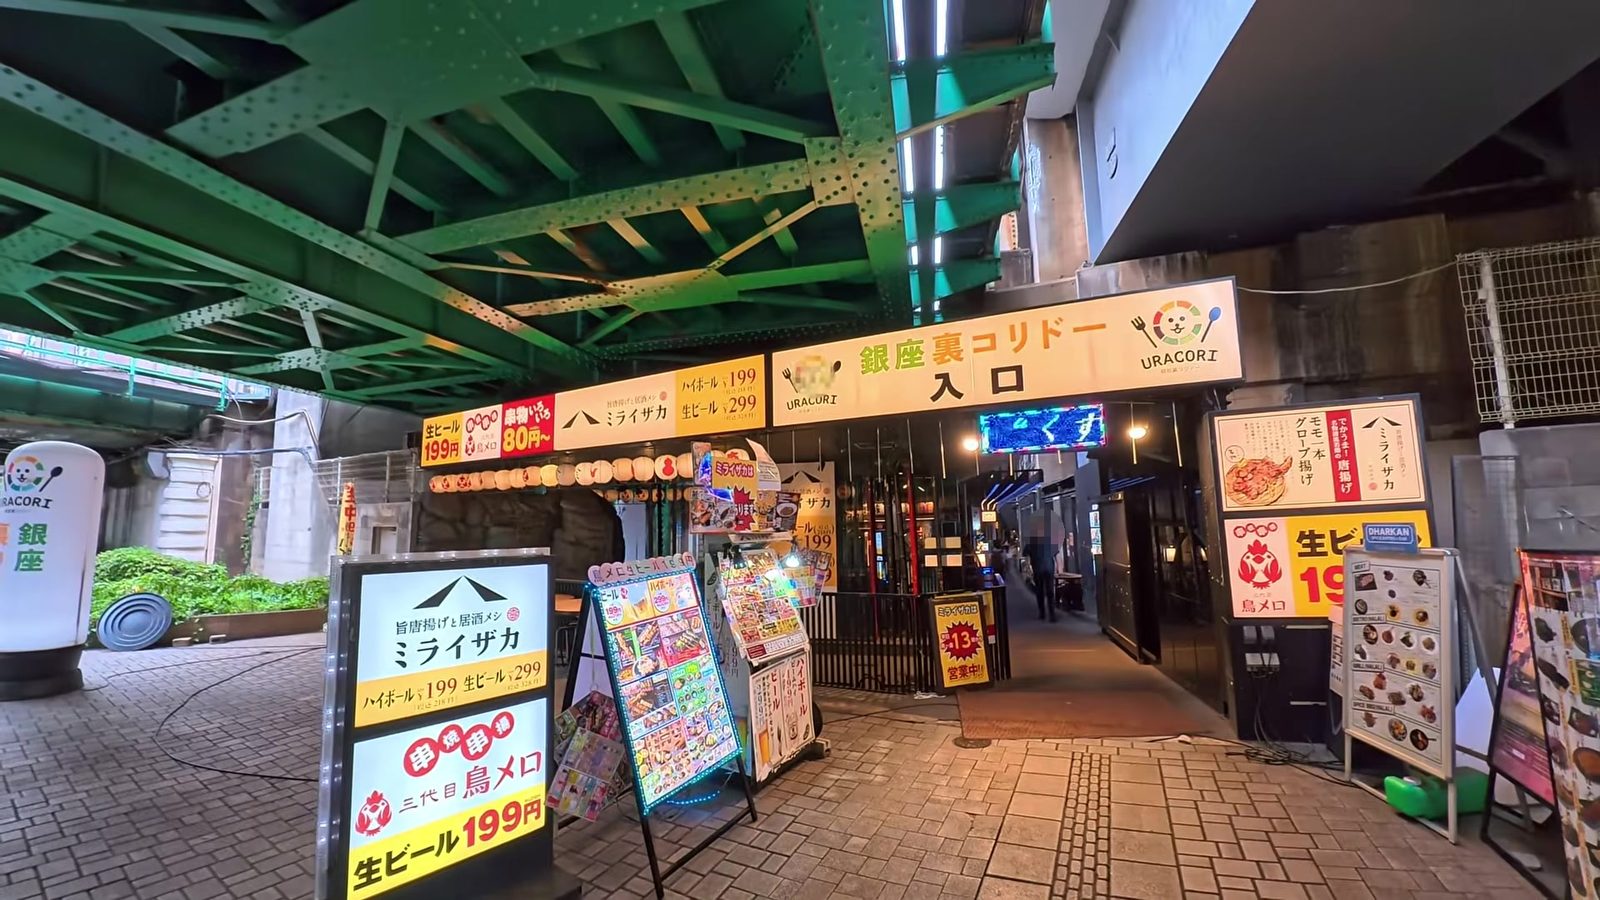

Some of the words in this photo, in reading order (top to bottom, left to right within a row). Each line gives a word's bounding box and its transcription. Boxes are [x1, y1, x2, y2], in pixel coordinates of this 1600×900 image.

[859, 317, 1107, 374] 銀座裏コリドー
[1141, 349, 1218, 370] URACORI
[681, 376, 719, 393] ハイボール
[930, 364, 1024, 402] 入口
[607, 404, 668, 427] ミライザカ
[681, 400, 719, 420] 生ビール
[425, 419, 461, 440] 生ビール
[1310, 416, 1326, 461] モモ一本
[424, 438, 459, 462] 199円
[1296, 416, 1314, 486] グローブ揚げ
[1379, 427, 1394, 491] ミライザカ
[715, 461, 755, 478] ミライザカは
[14, 522, 48, 572] 銀座
[1368, 527, 1410, 537] DHARKAN
[396, 611, 503, 635] 旨唐揚げと居酒メシ
[1241, 598, 1286, 613] 鳥メロ
[394, 626, 520, 669] ミライザカ
[951, 630, 972, 650] 13
[362, 688, 414, 710] ハイボール
[463, 669, 506, 693] 生ビール
[771, 670, 780, 712] ビール
[797, 658, 807, 717] ハイボール
[399, 782, 456, 813] 三代目
[462, 752, 542, 799] 鳥メロ
[353, 829, 460, 892] 生ビール
[462, 800, 541, 848] 199円
